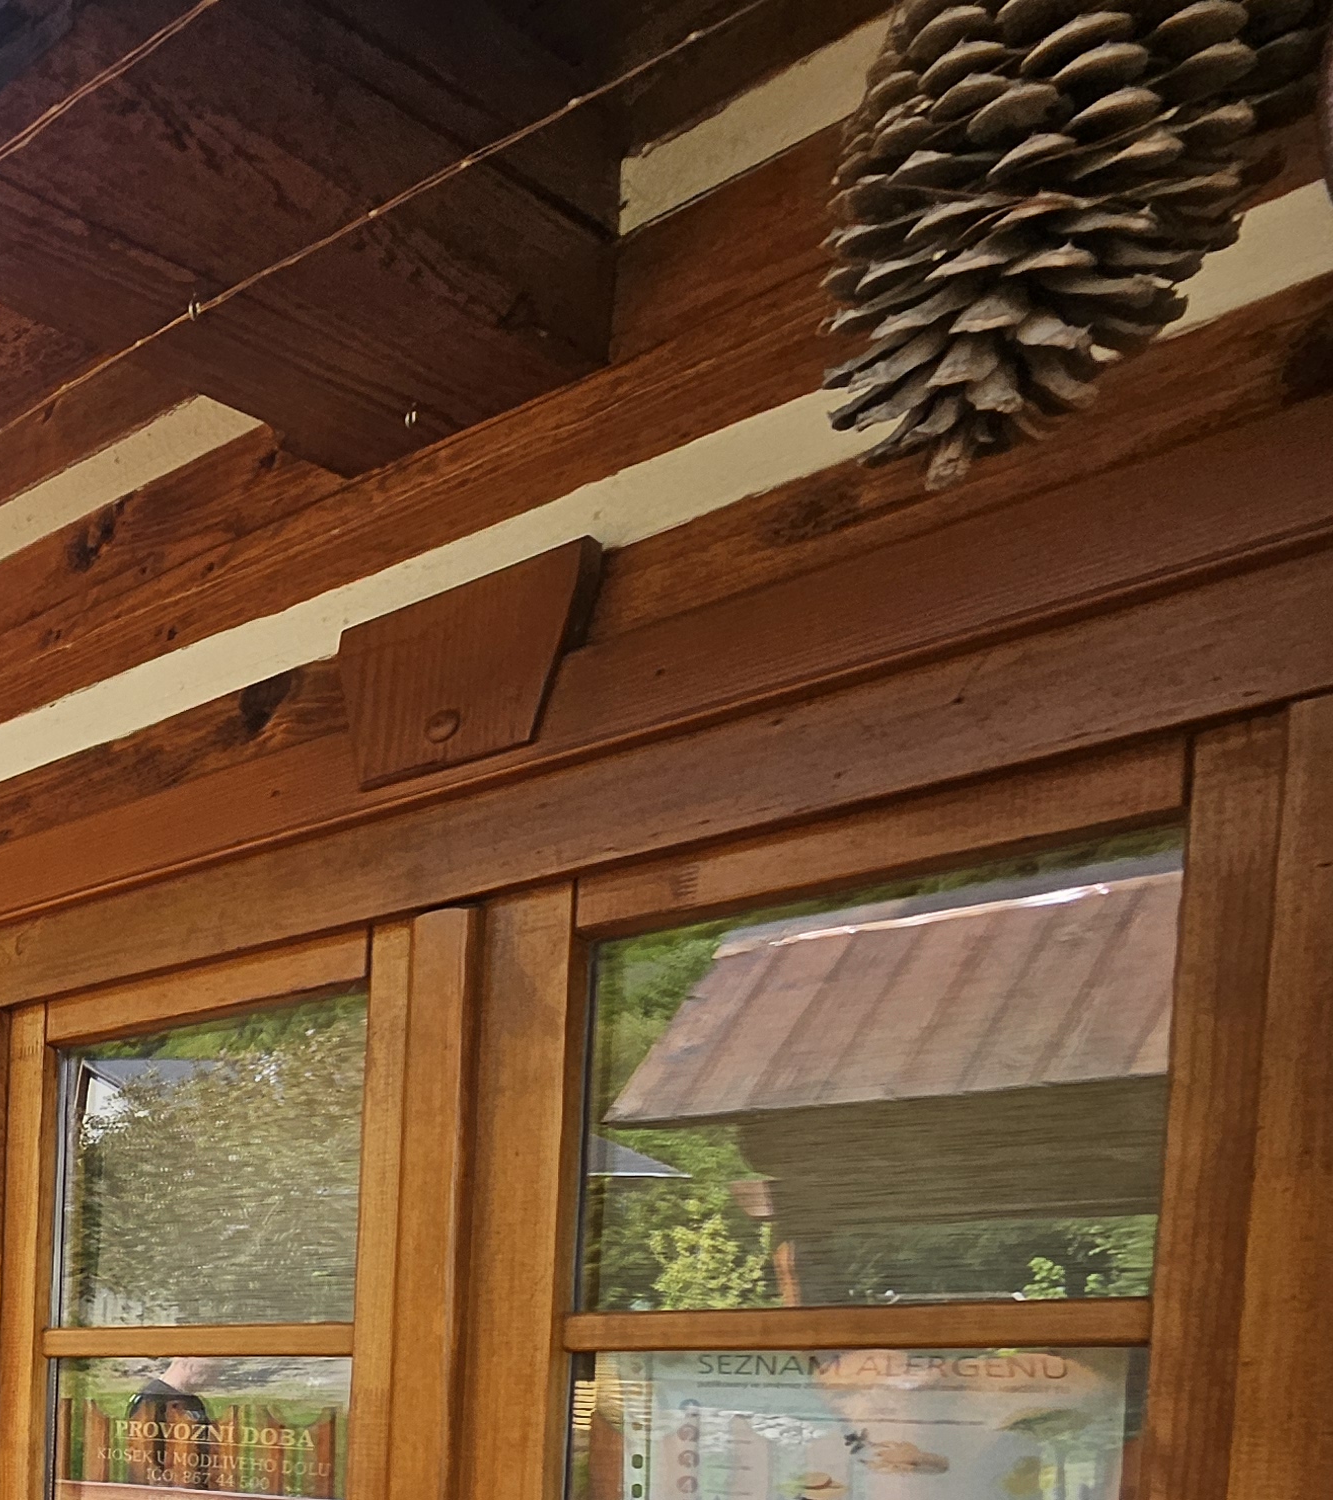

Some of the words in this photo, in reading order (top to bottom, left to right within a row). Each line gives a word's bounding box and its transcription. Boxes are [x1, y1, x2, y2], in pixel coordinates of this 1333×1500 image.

[697, 1354, 842, 1377] SEZNAM
[115, 1420, 235, 1444] PROVOZNÍ
[241, 1427, 315, 1448] DOBA
[97, 1448, 153, 1464] KIOSEK
[156, 1450, 167, 1465] U
[281, 1460, 331, 1477] DOLU
